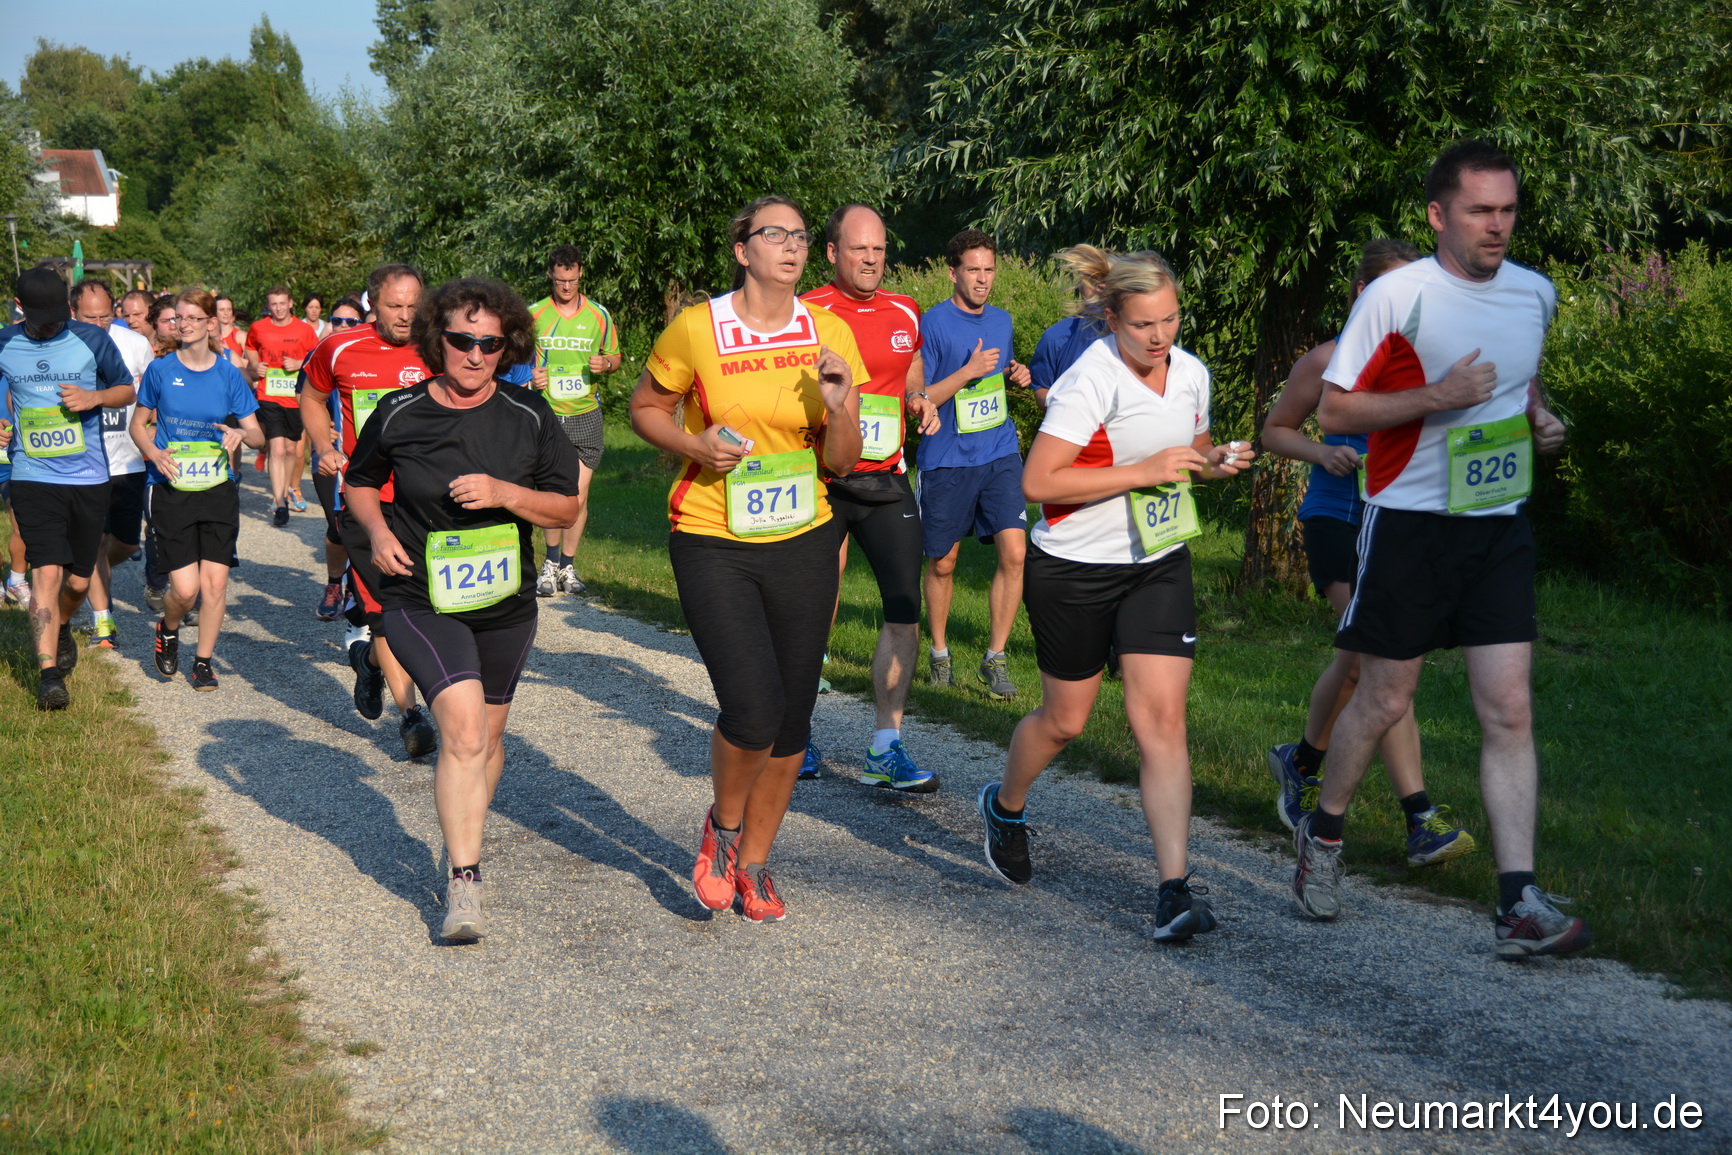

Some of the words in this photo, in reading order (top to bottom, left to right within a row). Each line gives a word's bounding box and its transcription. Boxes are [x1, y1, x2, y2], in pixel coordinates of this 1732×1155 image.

[538, 336, 594, 352] BOCK
[720, 357, 768, 376] MAX
[9, 372, 81, 384] SCHABMÜLLER
[270, 379, 296, 390] 1536
[557, 379, 582, 391] 136
[398, 393, 413, 401] JAKO
[967, 396, 999, 418] 784
[179, 418, 206, 428] LAUFEND
[29, 428, 76, 449] 6090
[175, 428, 200, 437] BEWEGT
[178, 461, 220, 478] 1441
[741, 468, 774, 477] firmenlauf
[1465, 451, 1517, 487] 826
[746, 484, 797, 515] 871
[1145, 492, 1181, 528] 827
[440, 543, 474, 552] firmenlauf
[438, 557, 509, 590] 1241
[476, 590, 495, 598] Distler
